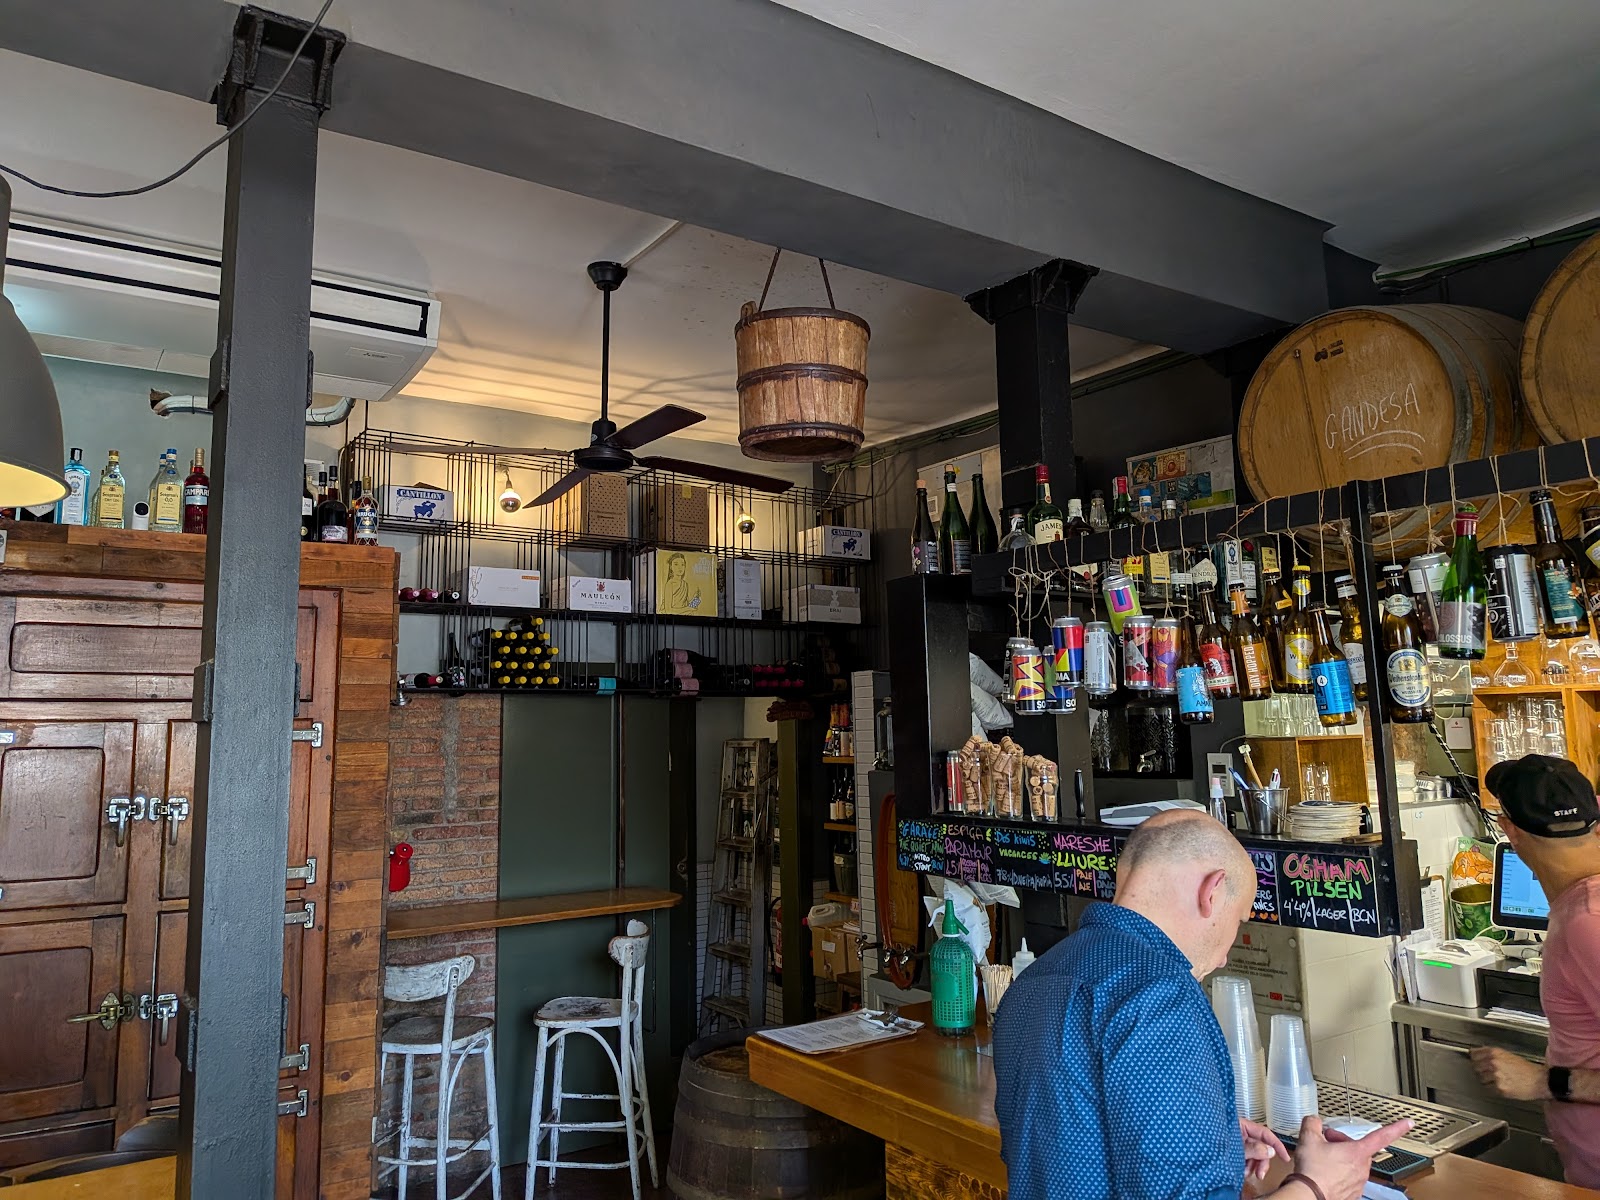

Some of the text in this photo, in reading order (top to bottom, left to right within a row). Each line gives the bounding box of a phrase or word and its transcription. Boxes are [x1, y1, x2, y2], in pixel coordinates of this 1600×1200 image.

[1325, 383, 1420, 449] GANDESA
[399, 489, 443, 500] CANTILLON
[581, 592, 621, 600] MAULEÓN
[1243, 646, 1261, 688] DRY HOPPED
[1553, 808, 1578, 817] STAFF
[902, 822, 939, 839] GARAGE
[948, 824, 984, 840] ESPIGA
[914, 853, 931, 862] NITRO
[1056, 852, 1110, 870] LLIURE
[914, 862, 931, 871] STOUT
[1076, 868, 1093, 880] PALE
[1283, 852, 1373, 885] OGHAM
[1078, 882, 1092, 891] ALE
[1291, 880, 1363, 900] PILSEN
[1316, 907, 1347, 919] LAGER
[1351, 908, 1376, 924] BCN
